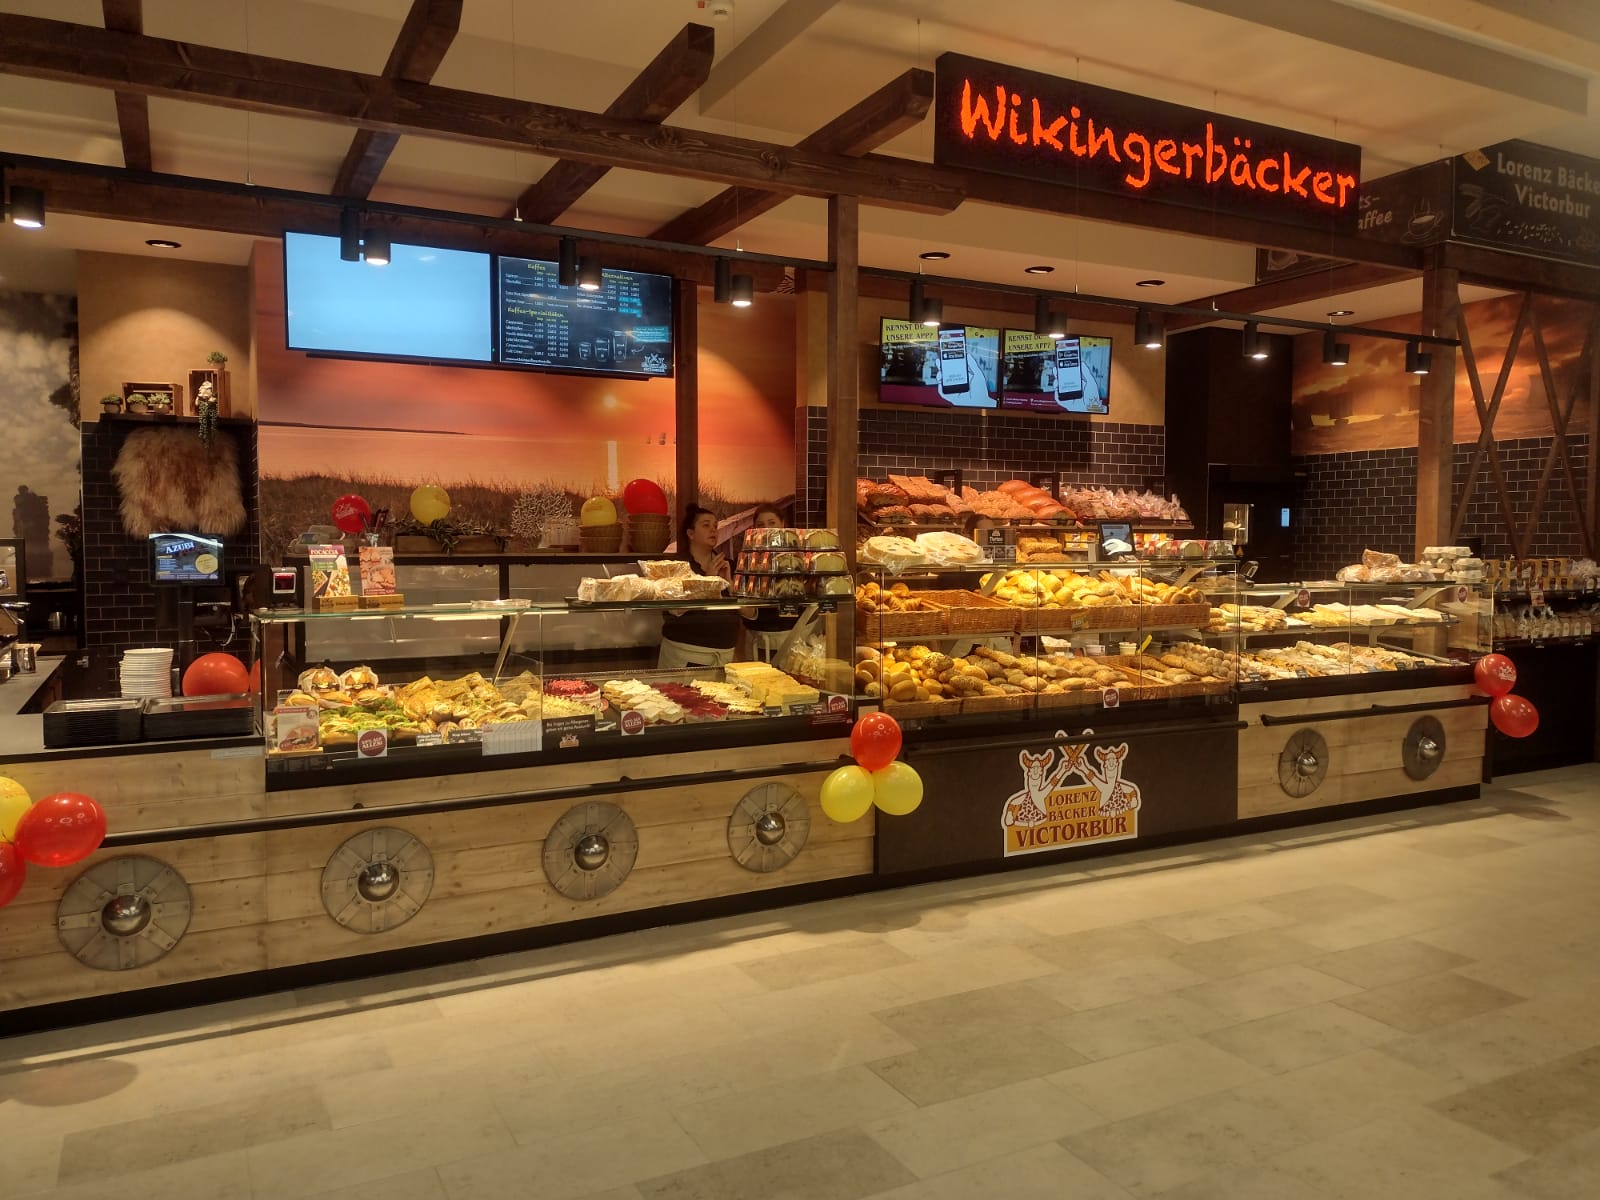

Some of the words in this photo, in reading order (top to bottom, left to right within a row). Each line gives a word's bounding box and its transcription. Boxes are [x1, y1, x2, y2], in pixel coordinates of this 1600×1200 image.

[960, 79, 1355, 207] Wikingerbäcker
[1497, 151, 1552, 182] Lorenz
[1514, 184, 1590, 218] Victorbur
[886, 334, 912, 342] UNSERE
[166, 541, 195, 554] AZUBI
[1048, 790, 1098, 807] LORENZ
[1049, 806, 1096, 822] BÄCKER
[1015, 816, 1128, 848] VICTORBUR
